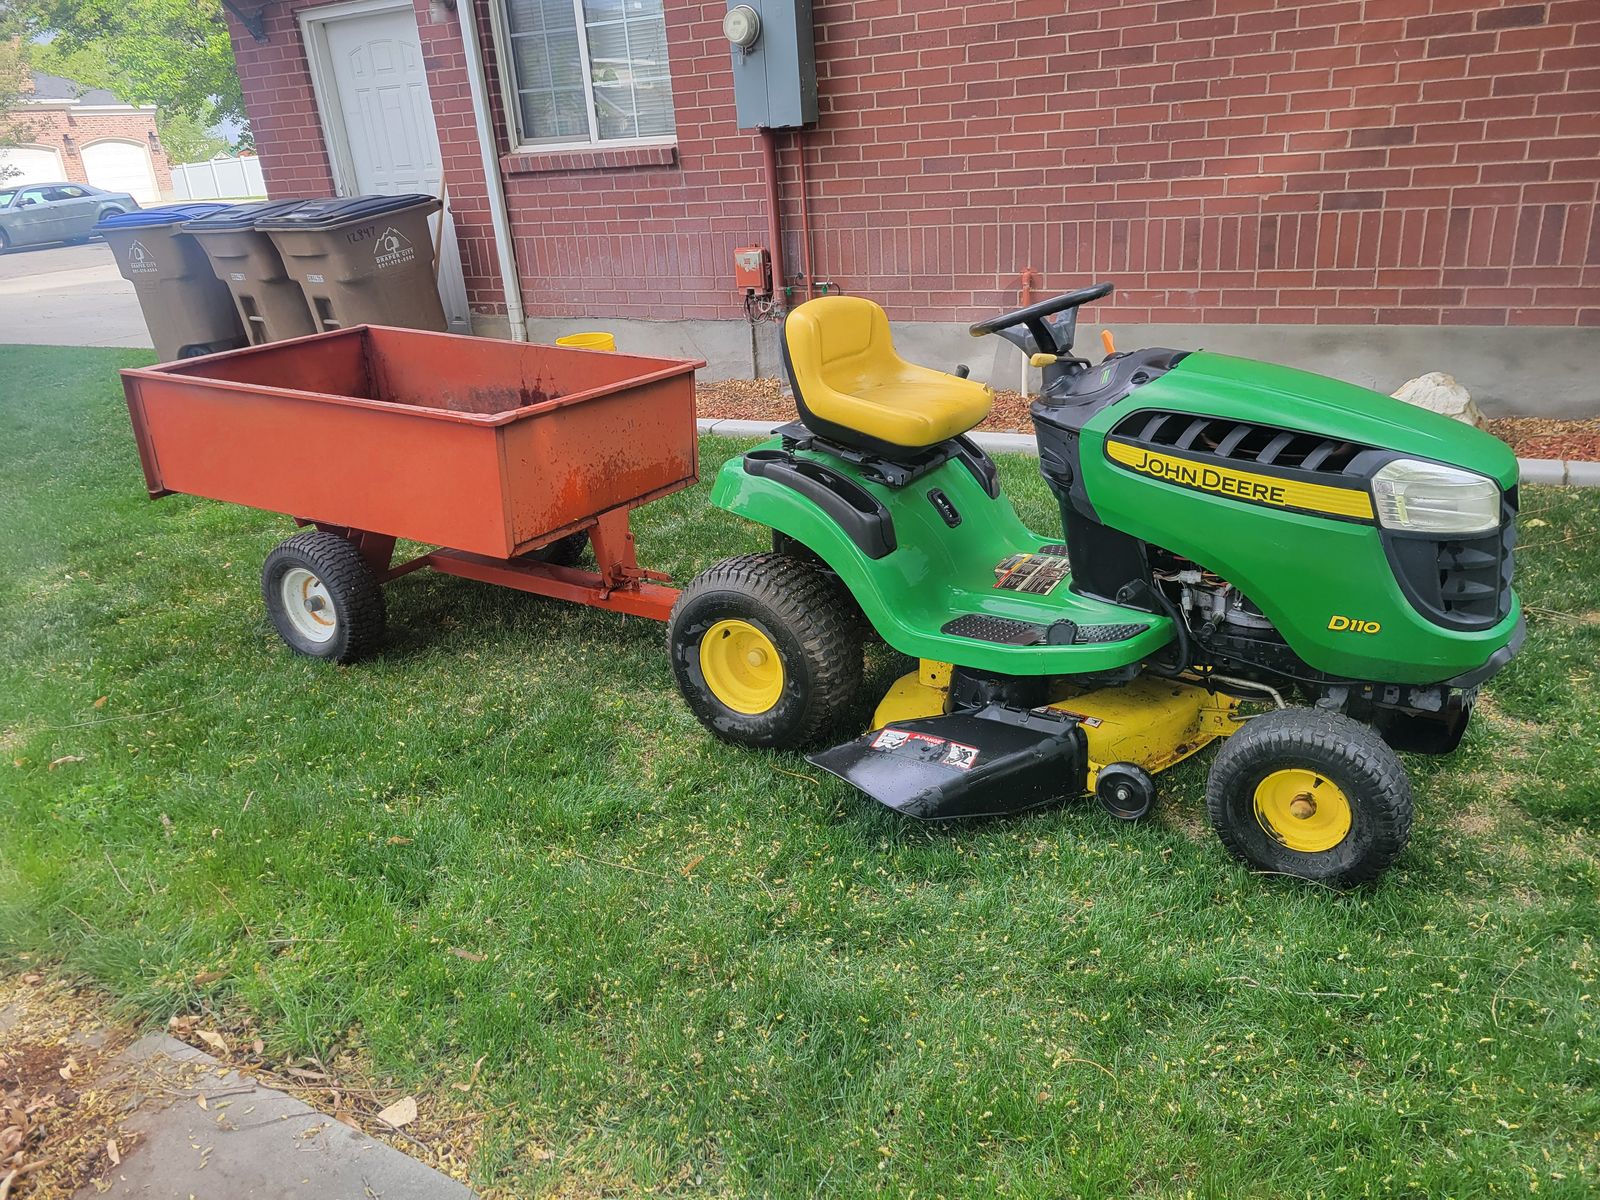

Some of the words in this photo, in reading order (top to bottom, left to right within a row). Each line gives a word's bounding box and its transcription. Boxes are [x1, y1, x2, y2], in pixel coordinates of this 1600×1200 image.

[346, 226, 375, 244] 12847
[376, 253, 400, 264] DRAPER
[401, 248, 414, 257] CITY
[1135, 453, 1197, 484] JOHN
[1202, 468, 1285, 503] DEERE
[1327, 615, 1381, 634] D110
